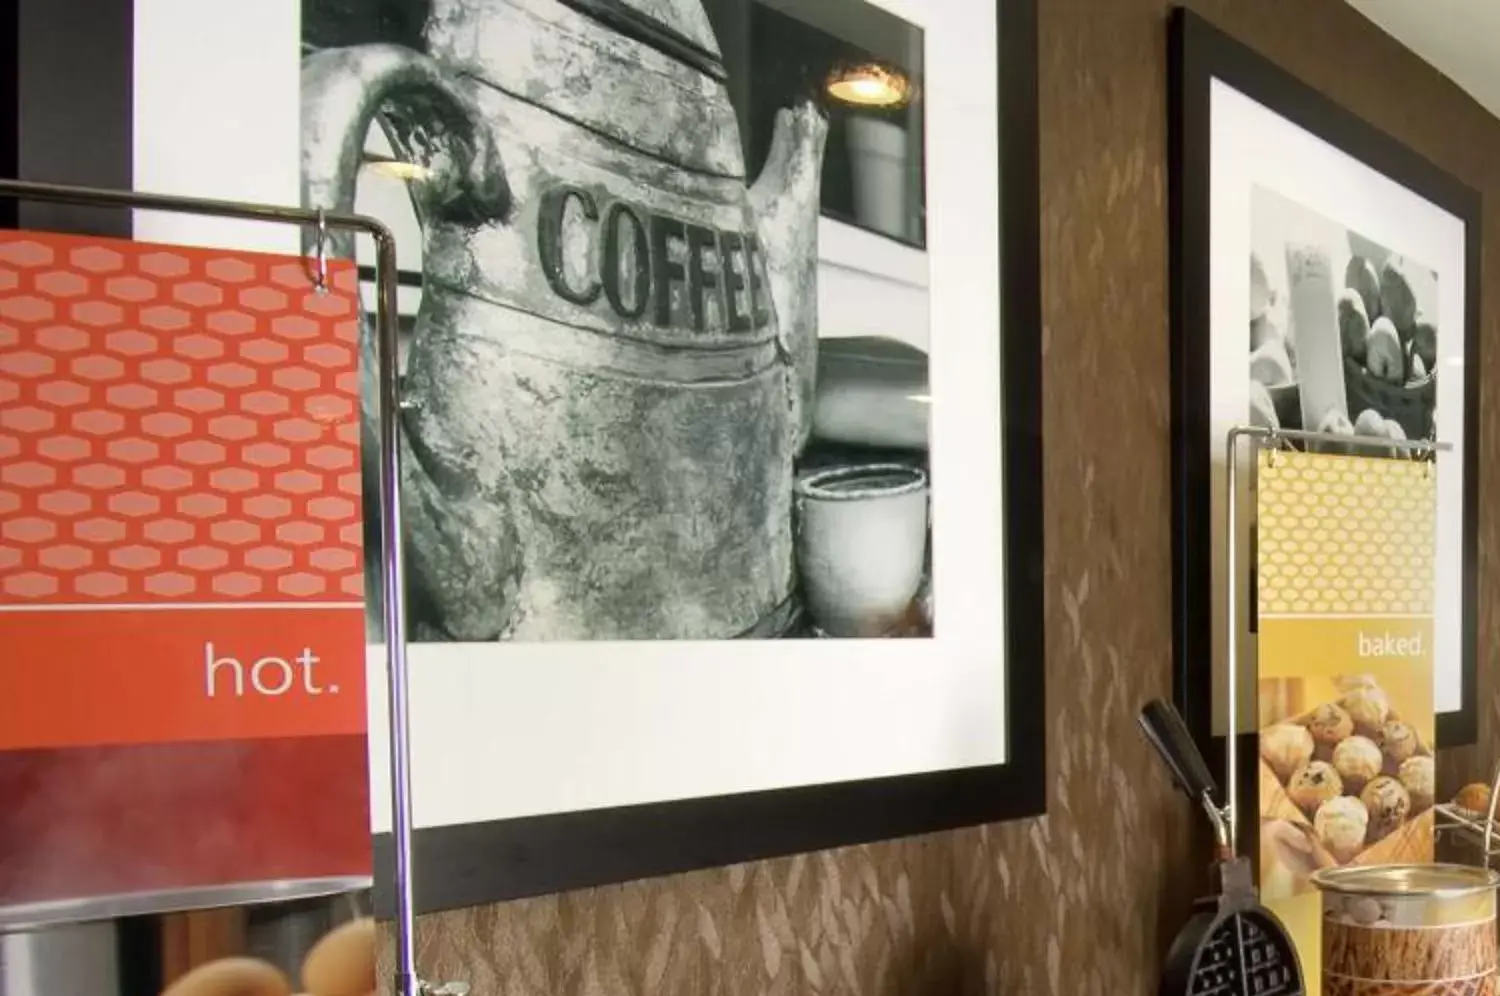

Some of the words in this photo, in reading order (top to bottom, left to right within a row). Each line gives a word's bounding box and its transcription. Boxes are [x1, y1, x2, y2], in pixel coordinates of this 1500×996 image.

[538, 184, 770, 334] COFFEE
[205, 640, 339, 697] hot.
[1359, 630, 1427, 657] baked.
